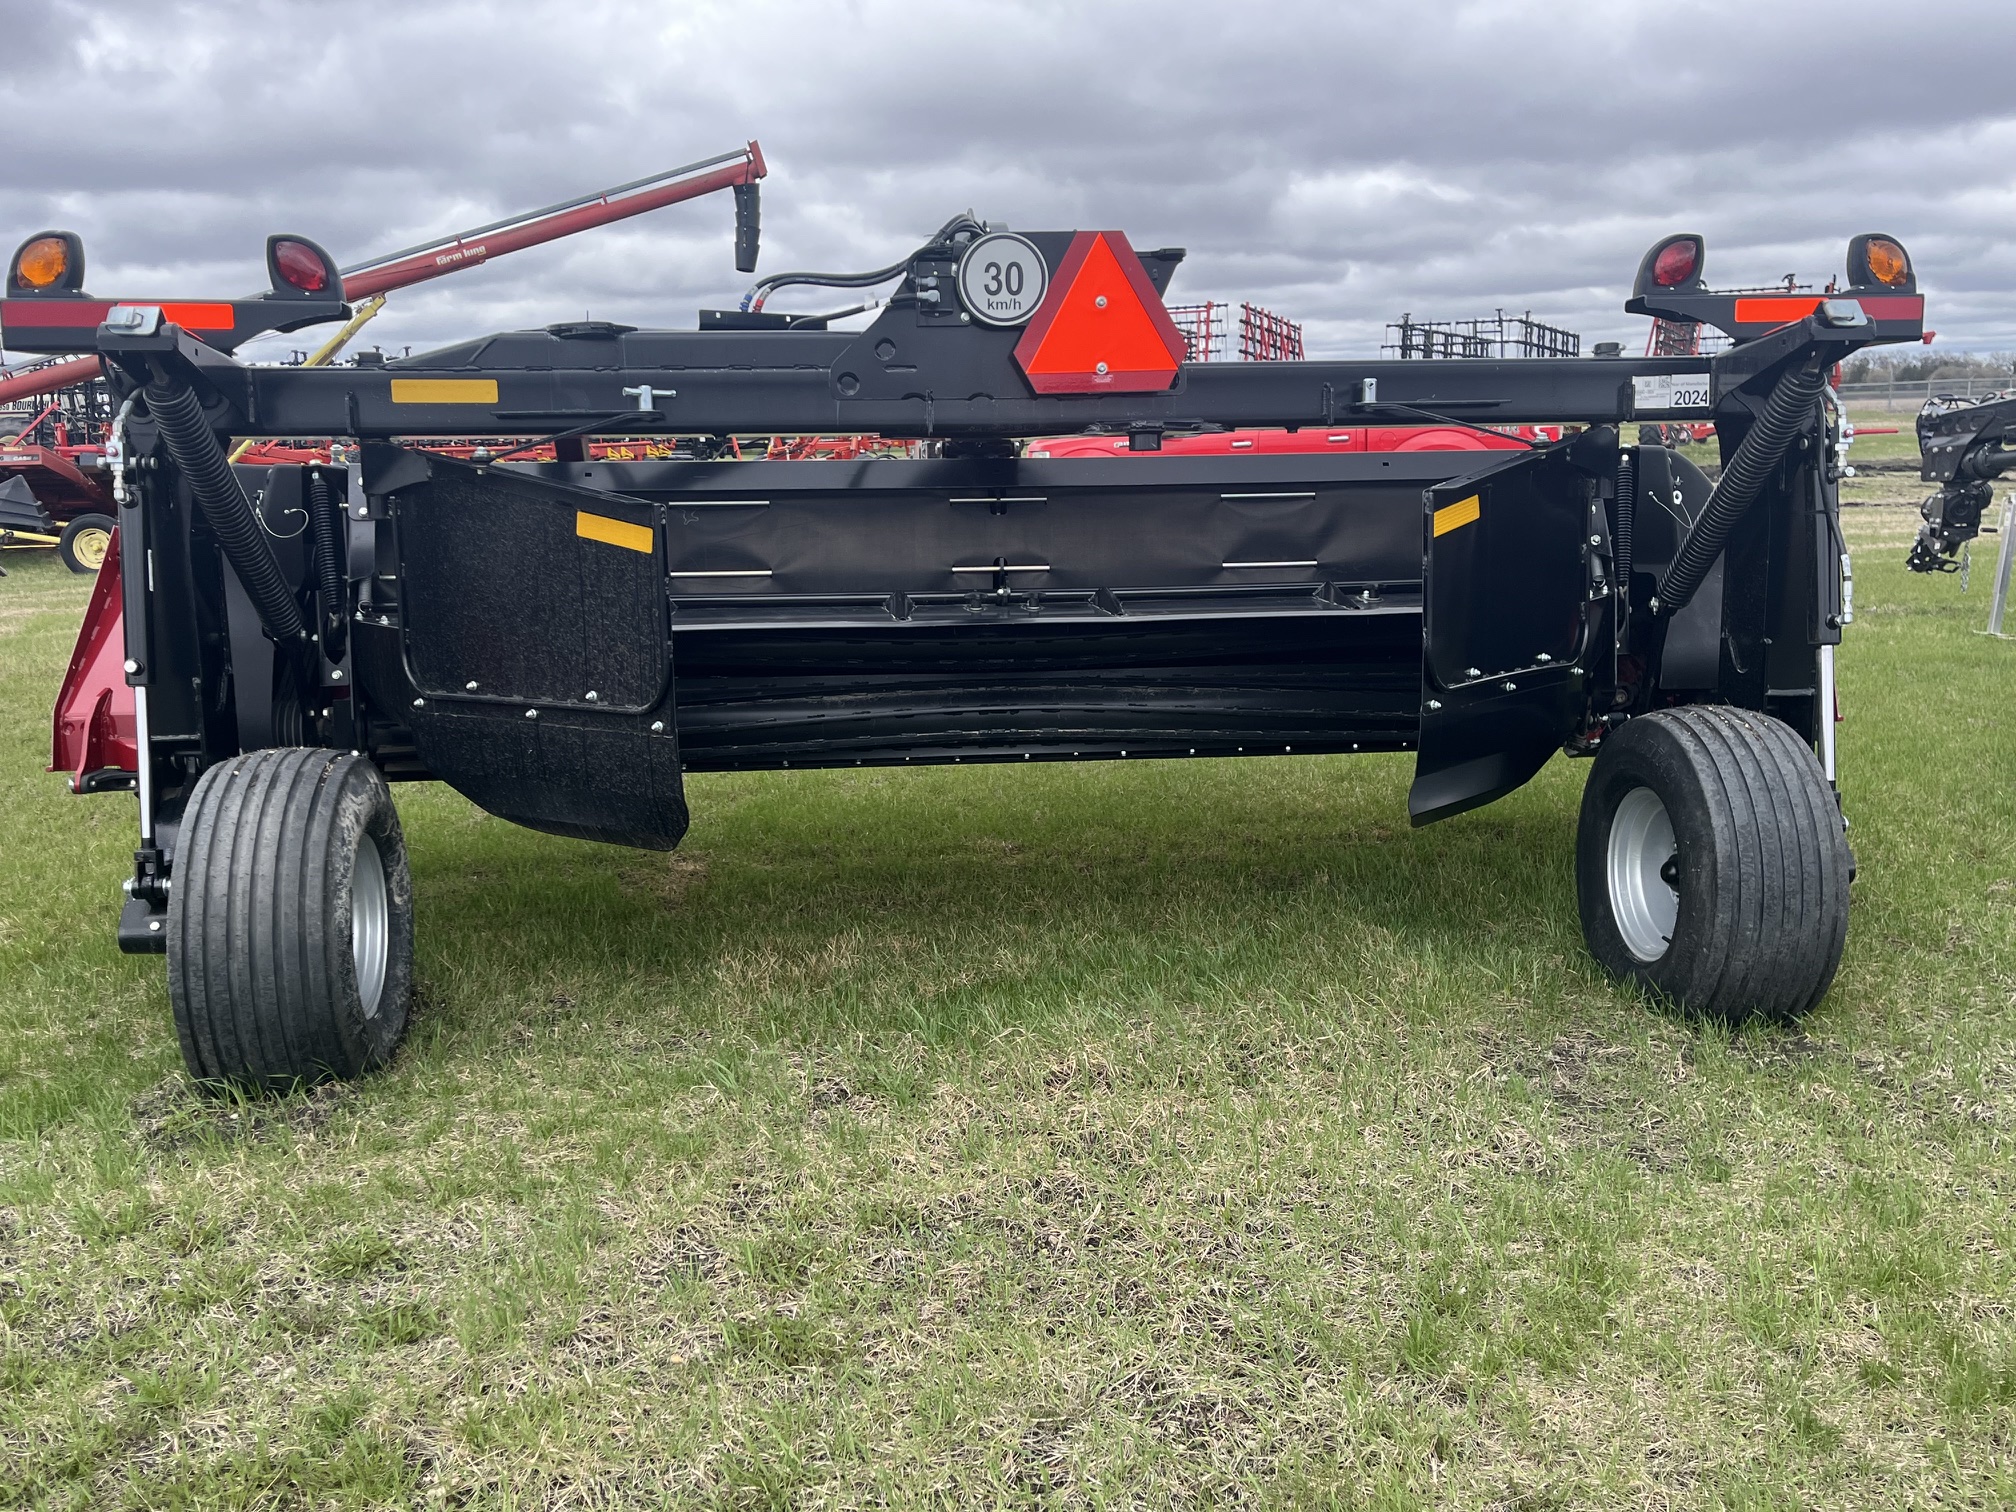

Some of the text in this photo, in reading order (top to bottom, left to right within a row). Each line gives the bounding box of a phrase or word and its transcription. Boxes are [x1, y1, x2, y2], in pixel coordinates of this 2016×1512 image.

[435, 252, 463, 266] Farm
[984, 261, 1024, 296] 30
[987, 298, 1022, 310] km/h
[1674, 390, 1709, 406] 2024
